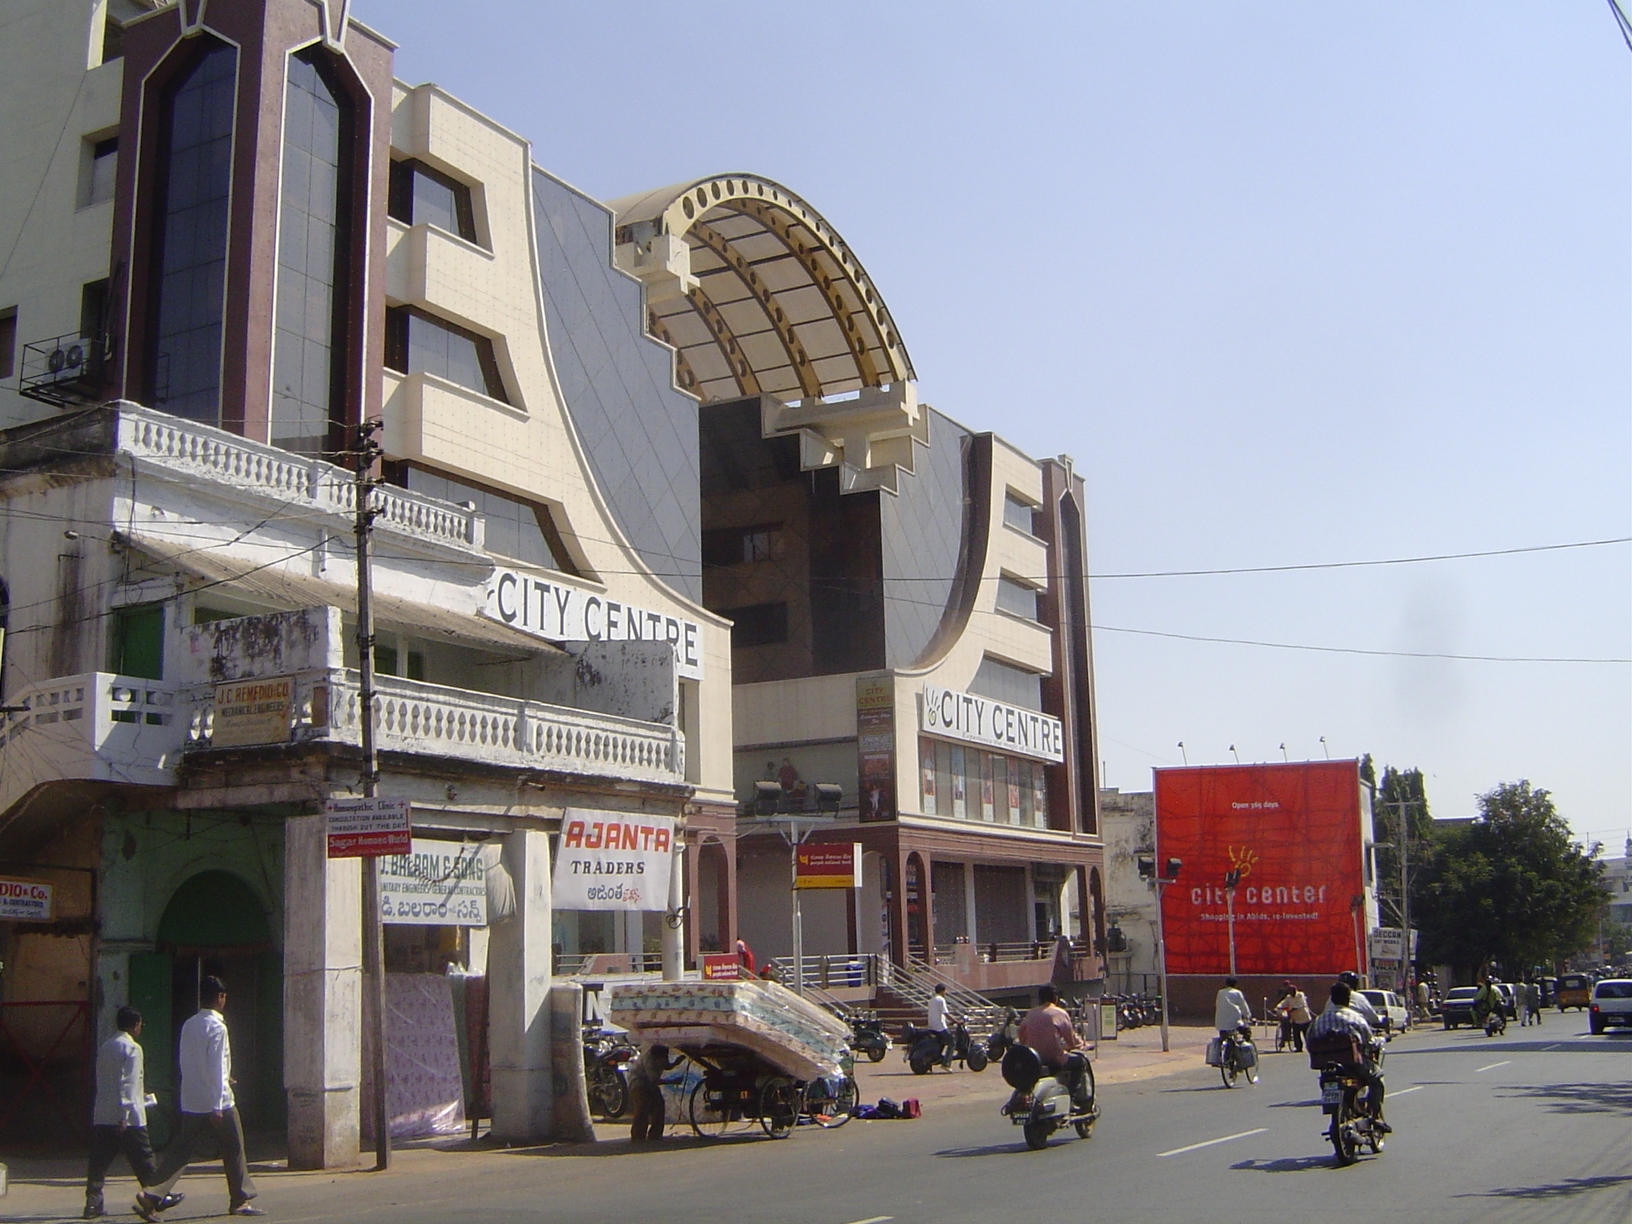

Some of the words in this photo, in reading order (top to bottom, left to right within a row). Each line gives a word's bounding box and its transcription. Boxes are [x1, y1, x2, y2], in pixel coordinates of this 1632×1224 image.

[497, 573, 571, 635] CITY
[585, 597, 698, 667] CENTRE
[941, 690, 984, 735] CITY
[992, 704, 1061, 754] CENTRE
[378, 800, 396, 811] Clinic
[1231, 801, 1249, 810] Open
[1263, 800, 1279, 809] days
[329, 836, 357, 850] Sagar
[565, 821, 670, 853] AJANTA
[454, 857, 483, 881] SONS
[570, 860, 645, 875] TRADERS
[31, 886, 47, 899] Co.
[1246, 885, 1327, 904] center
[1373, 930, 1402, 938] DECCAN
